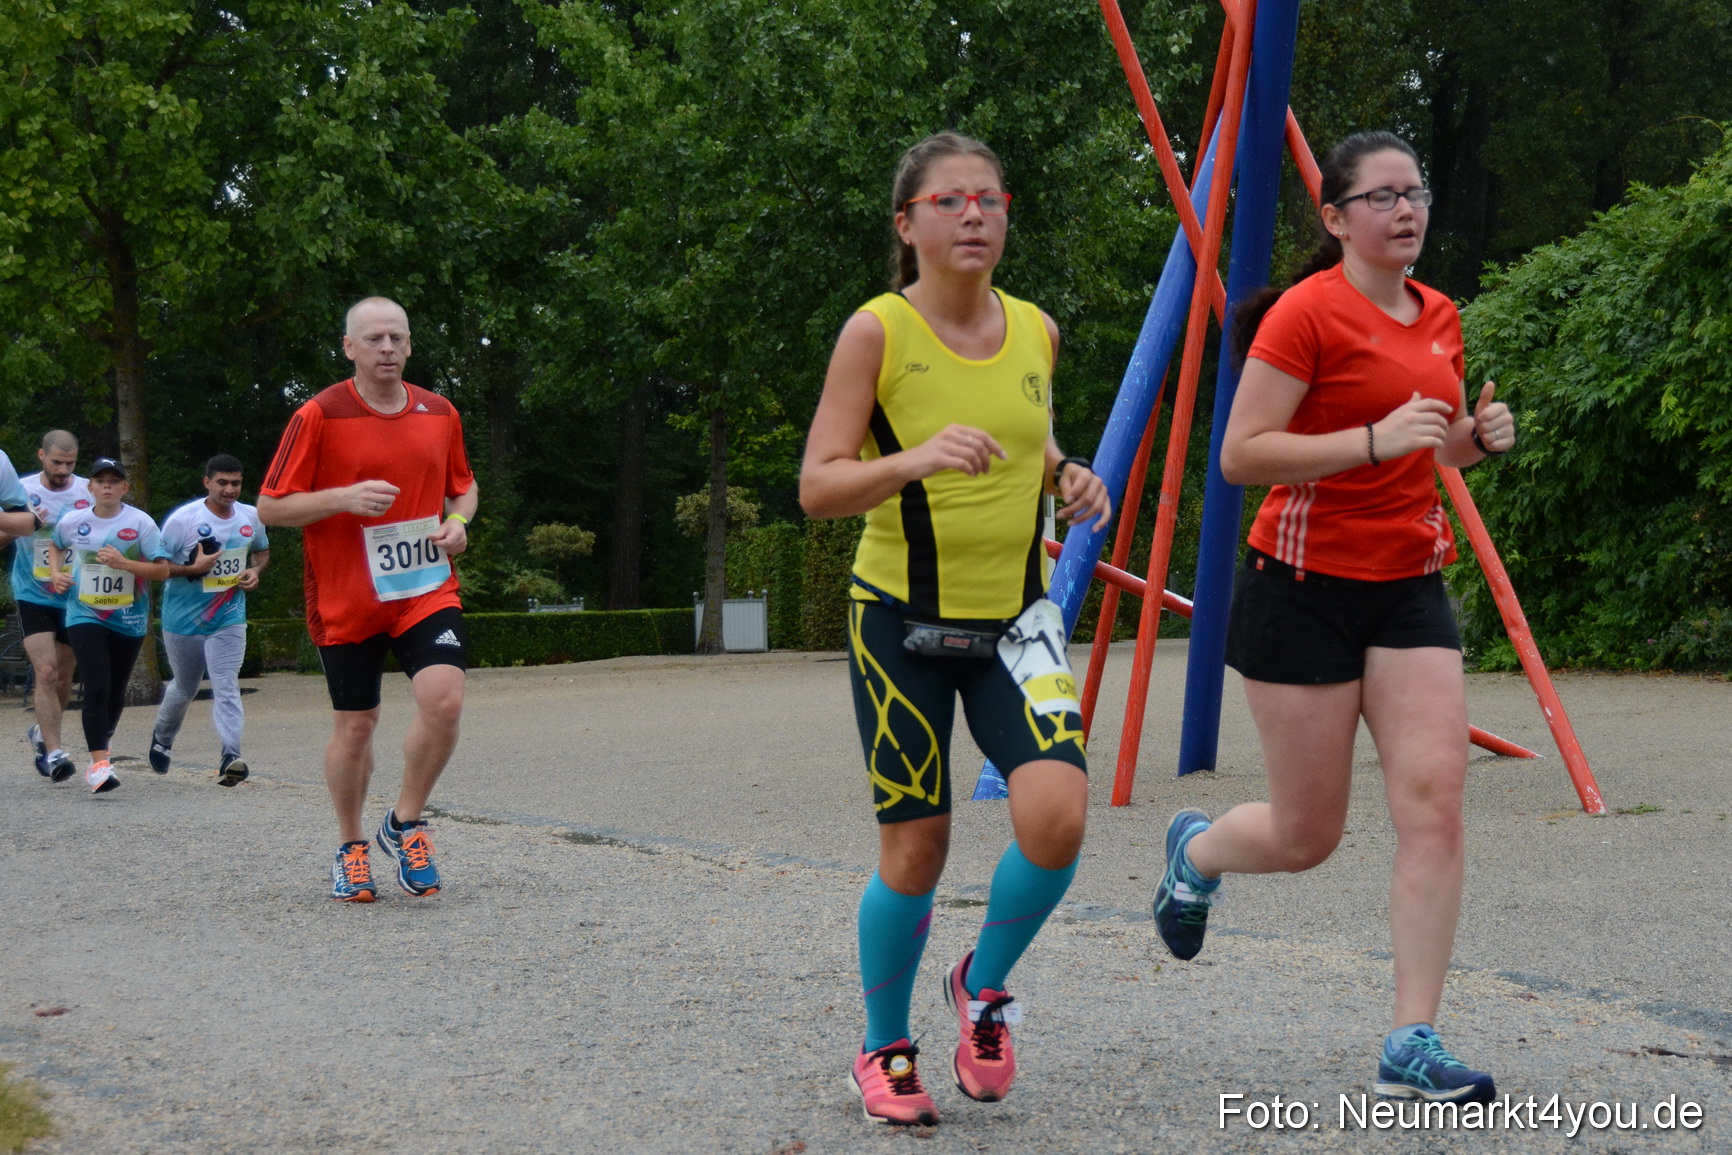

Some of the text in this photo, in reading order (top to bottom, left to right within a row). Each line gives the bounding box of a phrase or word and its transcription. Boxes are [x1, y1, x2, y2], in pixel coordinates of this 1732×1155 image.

[43, 549, 73, 565] 32
[377, 538, 440, 571] 3010
[213, 558, 240, 576] 333
[92, 576, 124, 594] 104
[94, 595, 119, 605] Sophia
[435, 638, 461, 647] adidas
